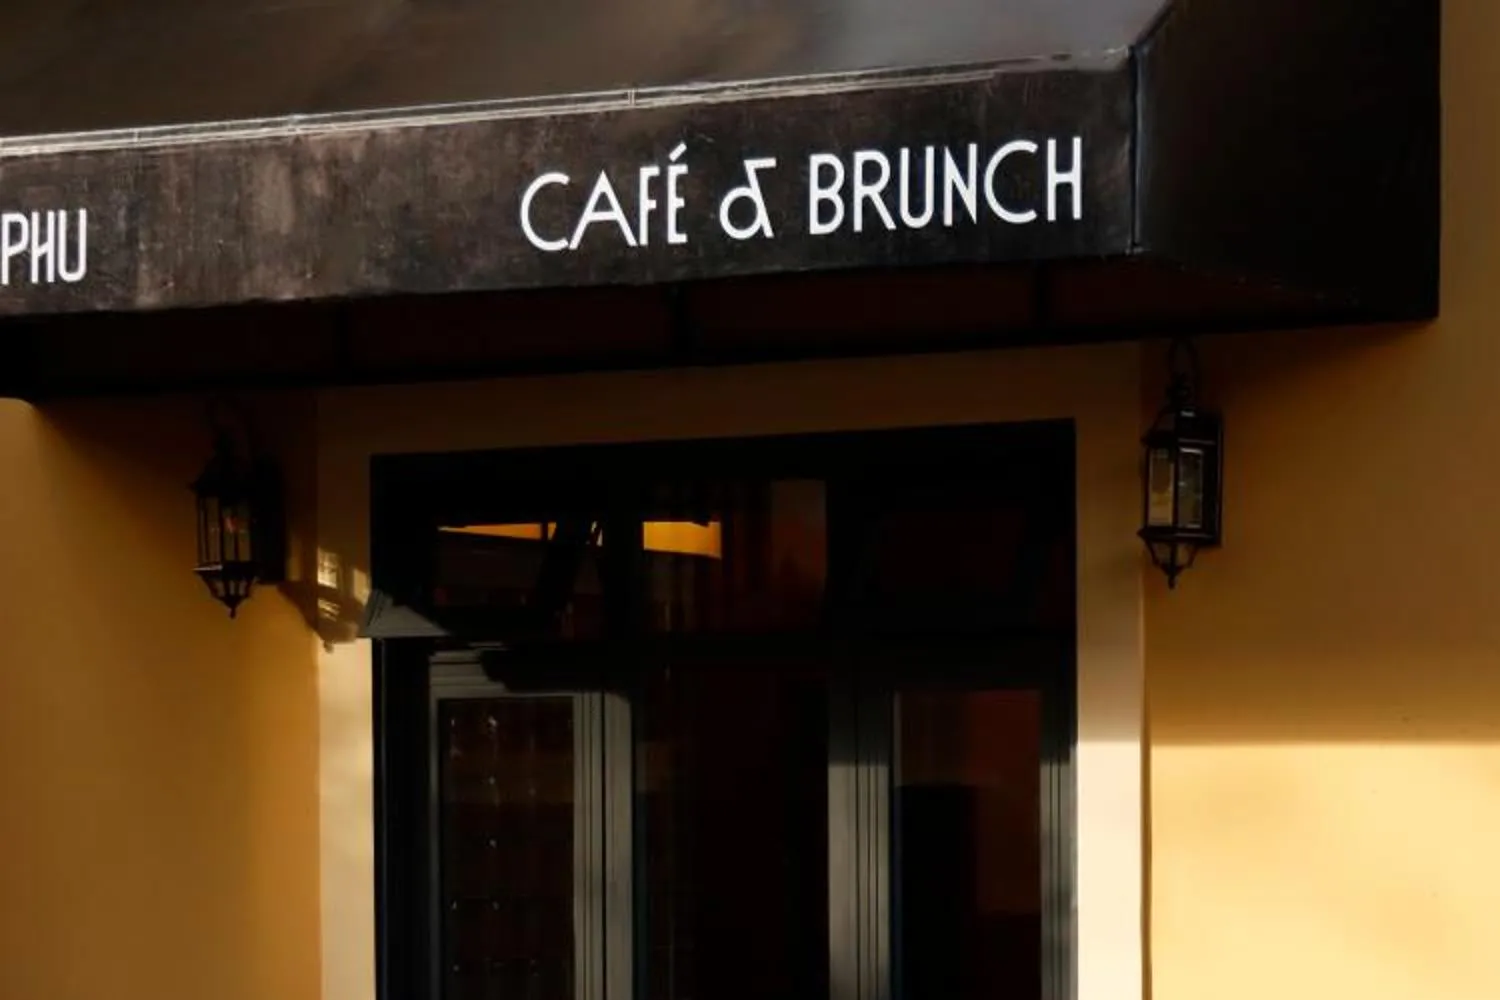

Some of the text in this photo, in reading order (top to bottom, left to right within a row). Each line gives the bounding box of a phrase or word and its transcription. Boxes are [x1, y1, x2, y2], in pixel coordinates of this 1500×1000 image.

[519, 136, 1083, 252] CAFÉ & BRUNCH
[1, 207, 88, 286] PHU
